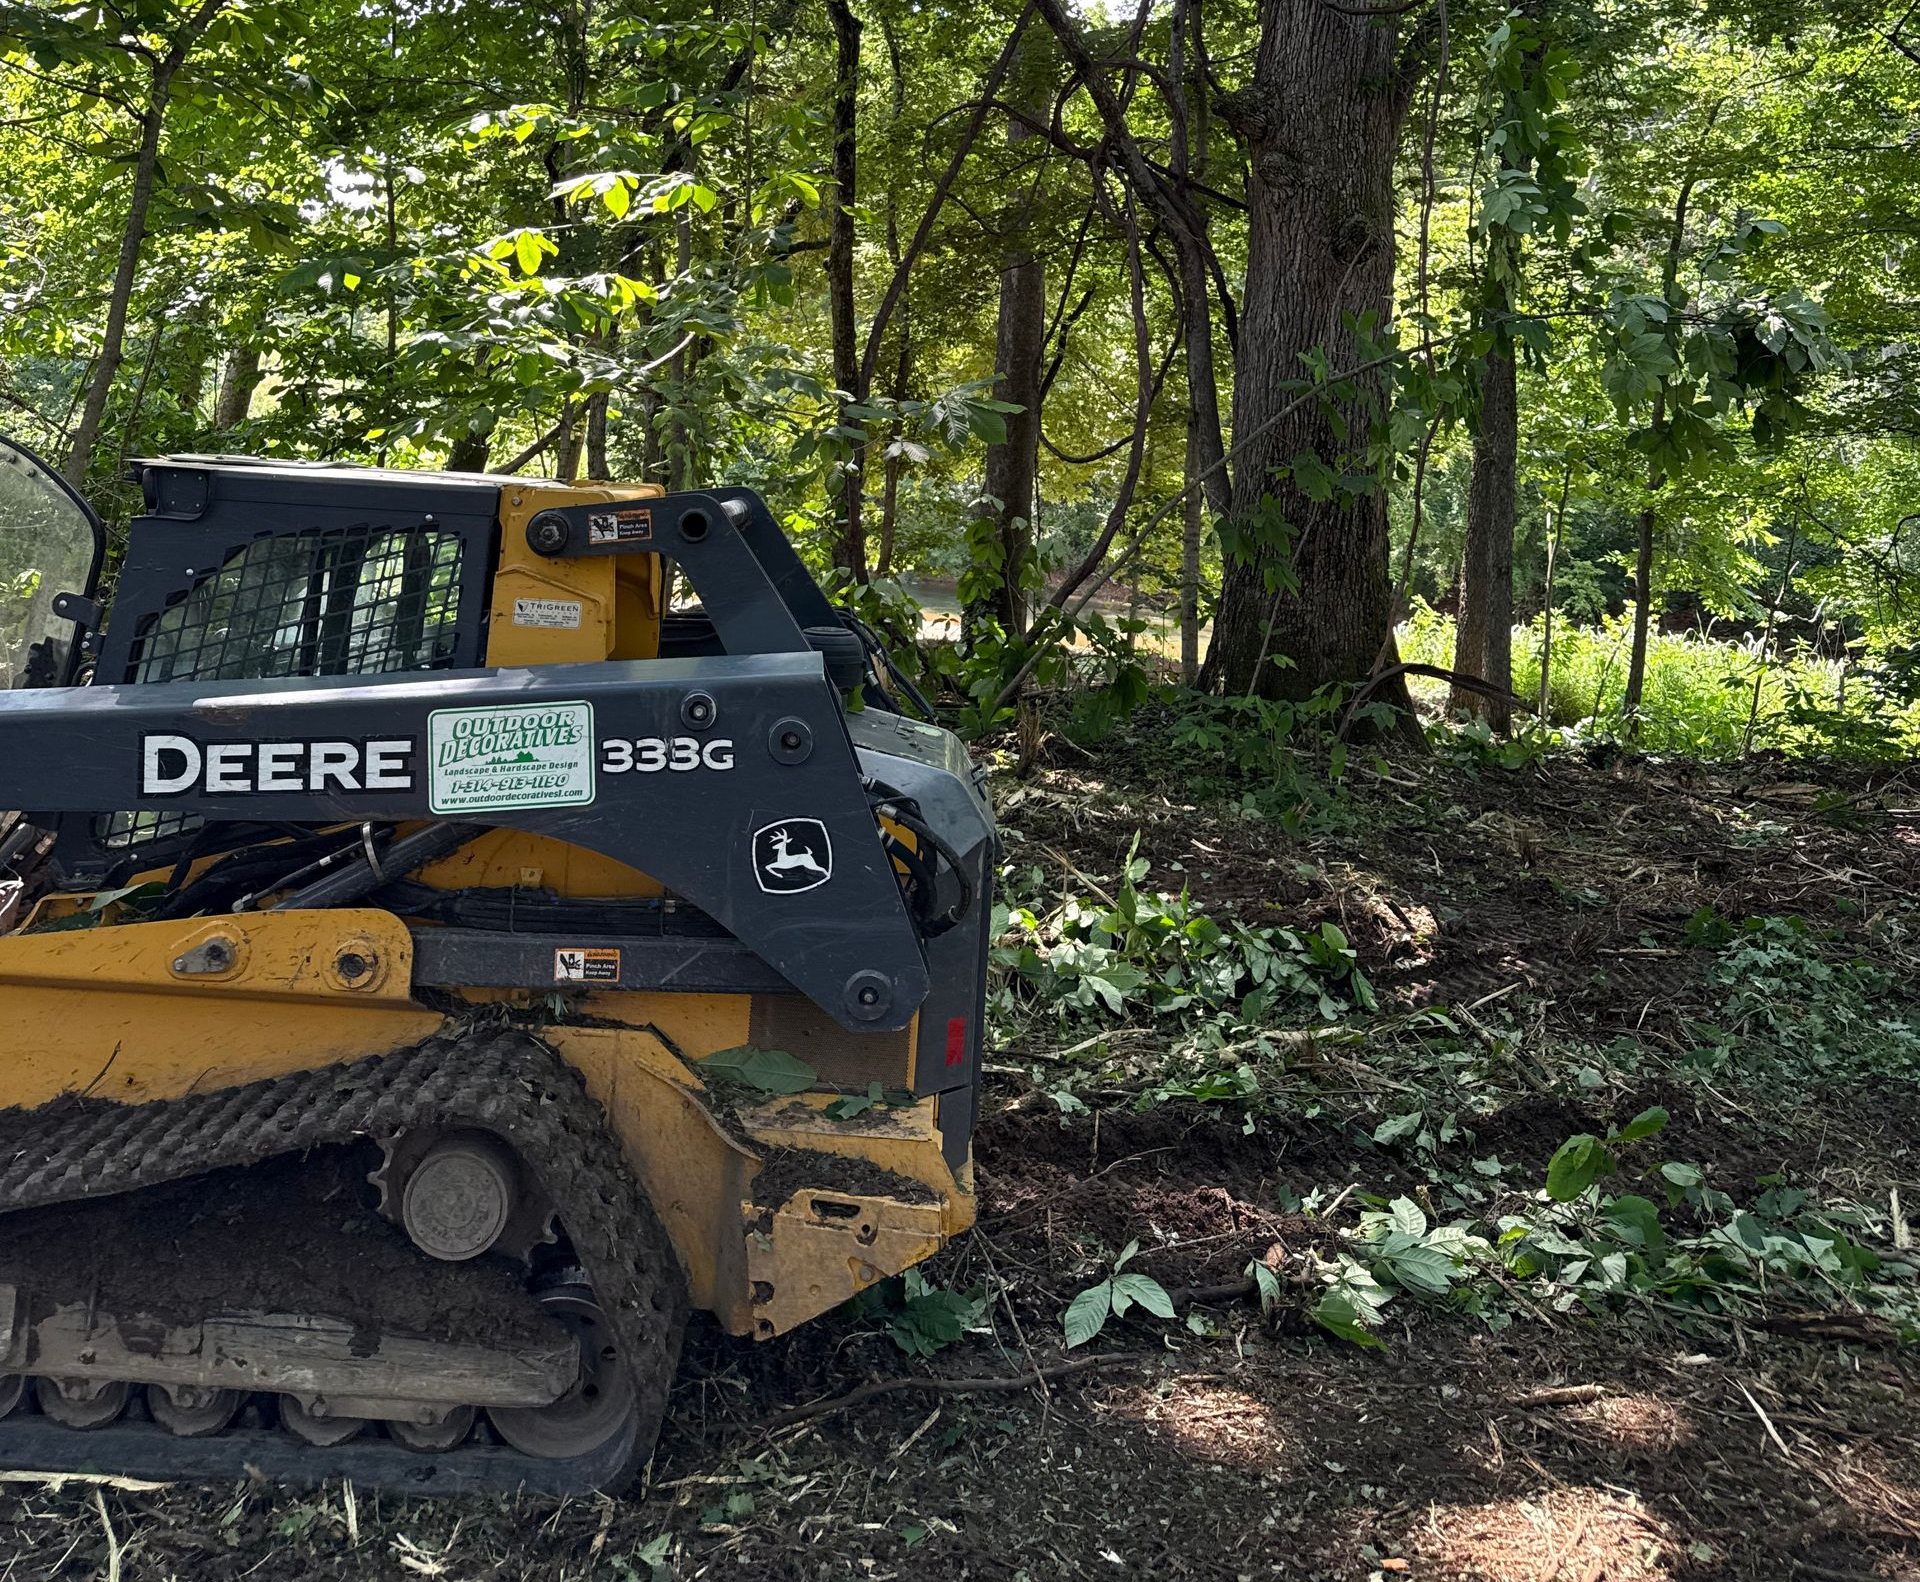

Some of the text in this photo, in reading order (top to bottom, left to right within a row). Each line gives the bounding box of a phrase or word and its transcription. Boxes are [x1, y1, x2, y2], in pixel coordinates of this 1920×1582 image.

[453, 710, 576, 740] OUTDOOR
[438, 724, 584, 768] DECORATIVES
[143, 735, 734, 794] DEERE 333G
[444, 761, 579, 776] Landscape & Hardscape Design
[451, 773, 570, 795] 1-314-913-1190
